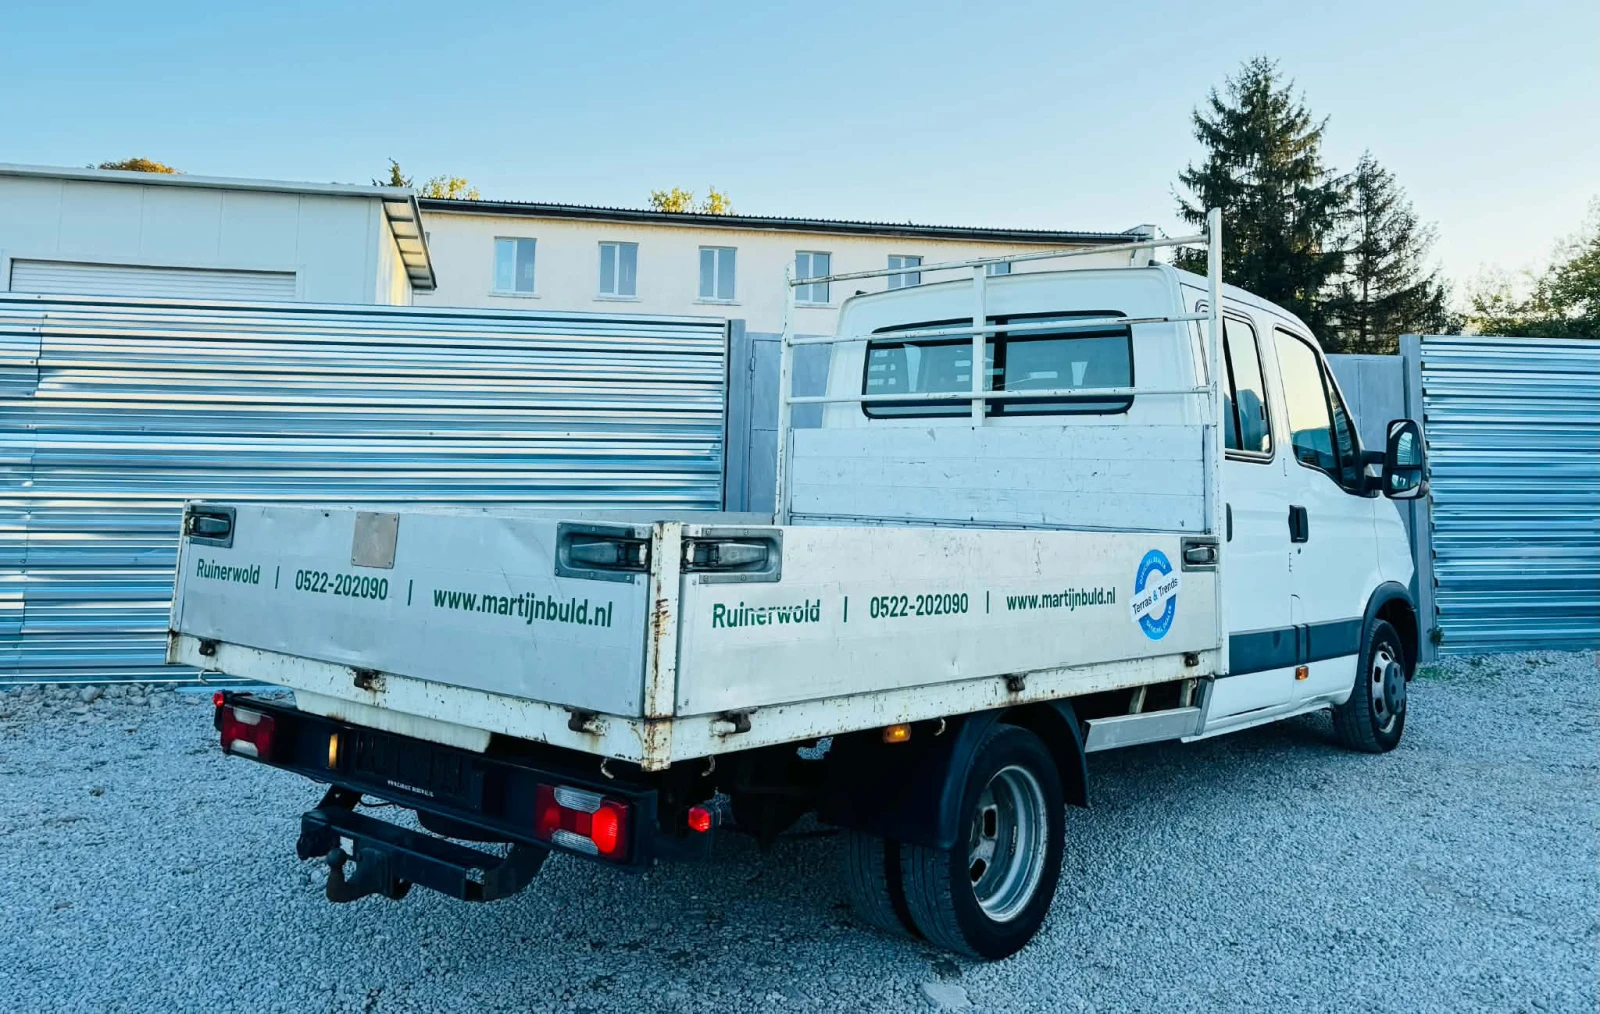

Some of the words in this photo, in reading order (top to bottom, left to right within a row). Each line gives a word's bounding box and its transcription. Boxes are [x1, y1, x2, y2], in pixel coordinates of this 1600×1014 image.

[197, 558, 261, 585] Ruinerwold
[296, 569, 389, 601] 0522-202090
[434, 589, 613, 628] www.martijnbuld.nl
[712, 599, 821, 629] Ruinerwold
[869, 593, 969, 619] 0522-202090
[1006, 586, 1116, 612] www.martijnbuld.nl
[1132, 596, 1152, 615] Terras
[1152, 589, 1158, 601] &
[1158, 578, 1178, 597] Trends
